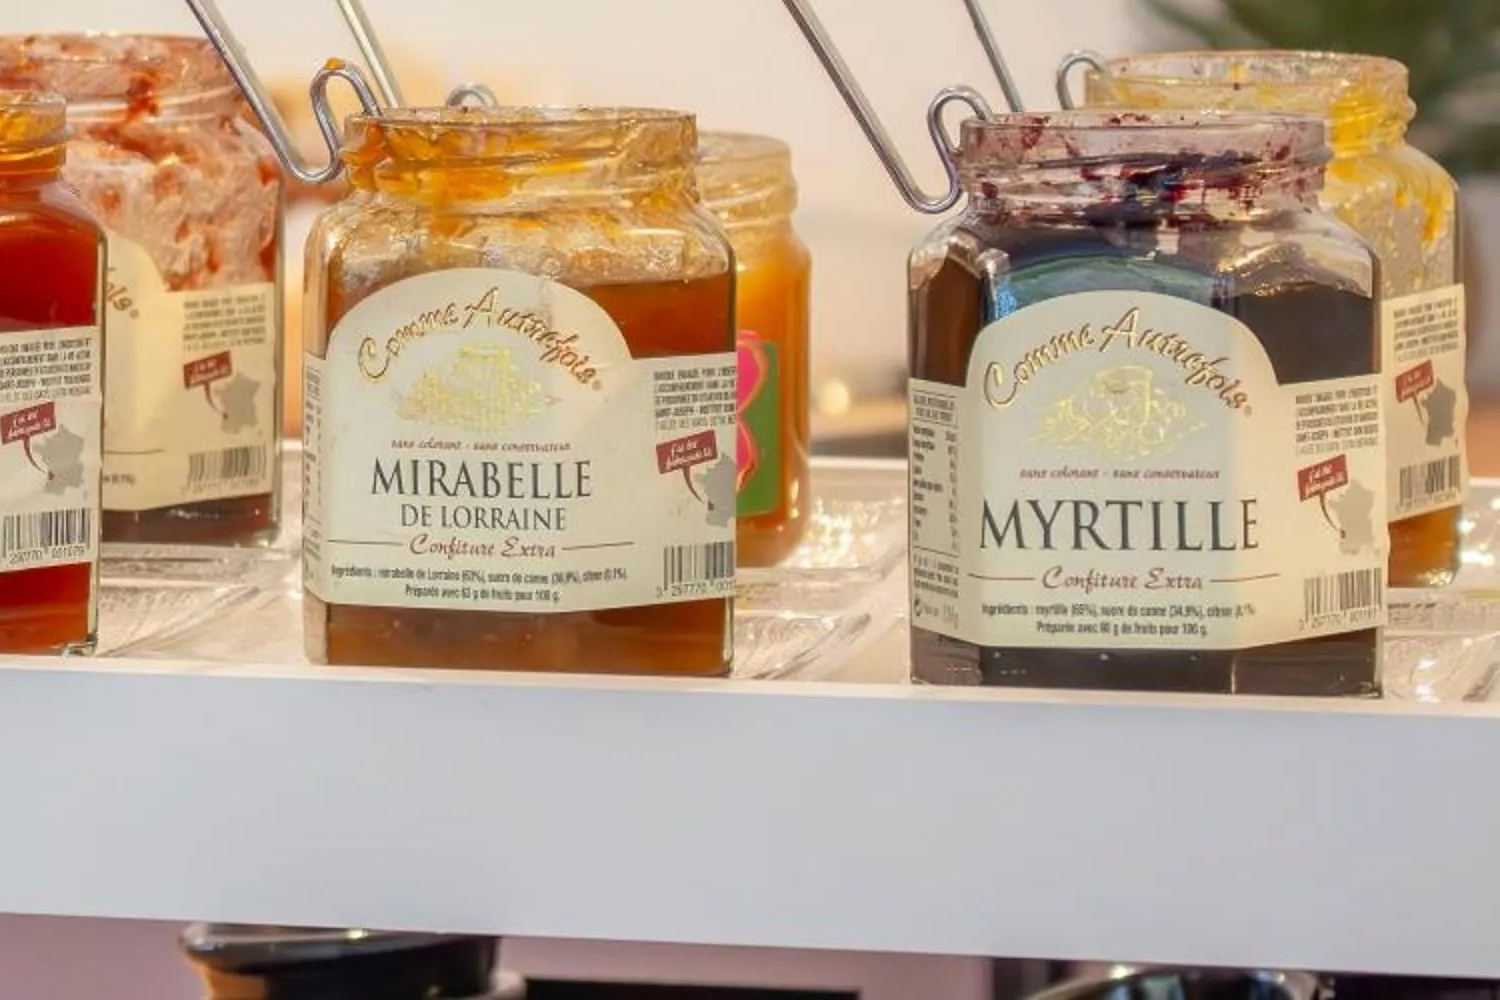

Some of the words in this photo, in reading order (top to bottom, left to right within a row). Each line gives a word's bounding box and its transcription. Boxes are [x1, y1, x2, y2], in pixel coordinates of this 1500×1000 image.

[358, 302, 459, 379] Comme
[464, 286, 597, 385] Autrefois
[984, 323, 1095, 407] Comme
[1099, 306, 1248, 409] Autrefois
[371, 457, 592, 499] MIRABELLE
[401, 503, 431, 527] DE
[441, 504, 566, 531] LORRAINE
[979, 499, 1259, 551] MYRTILLE
[410, 533, 494, 559] Confiture
[500, 536, 555, 558] Extra
[1041, 565, 1138, 593] Confiture
[1144, 567, 1204, 591] Extra
